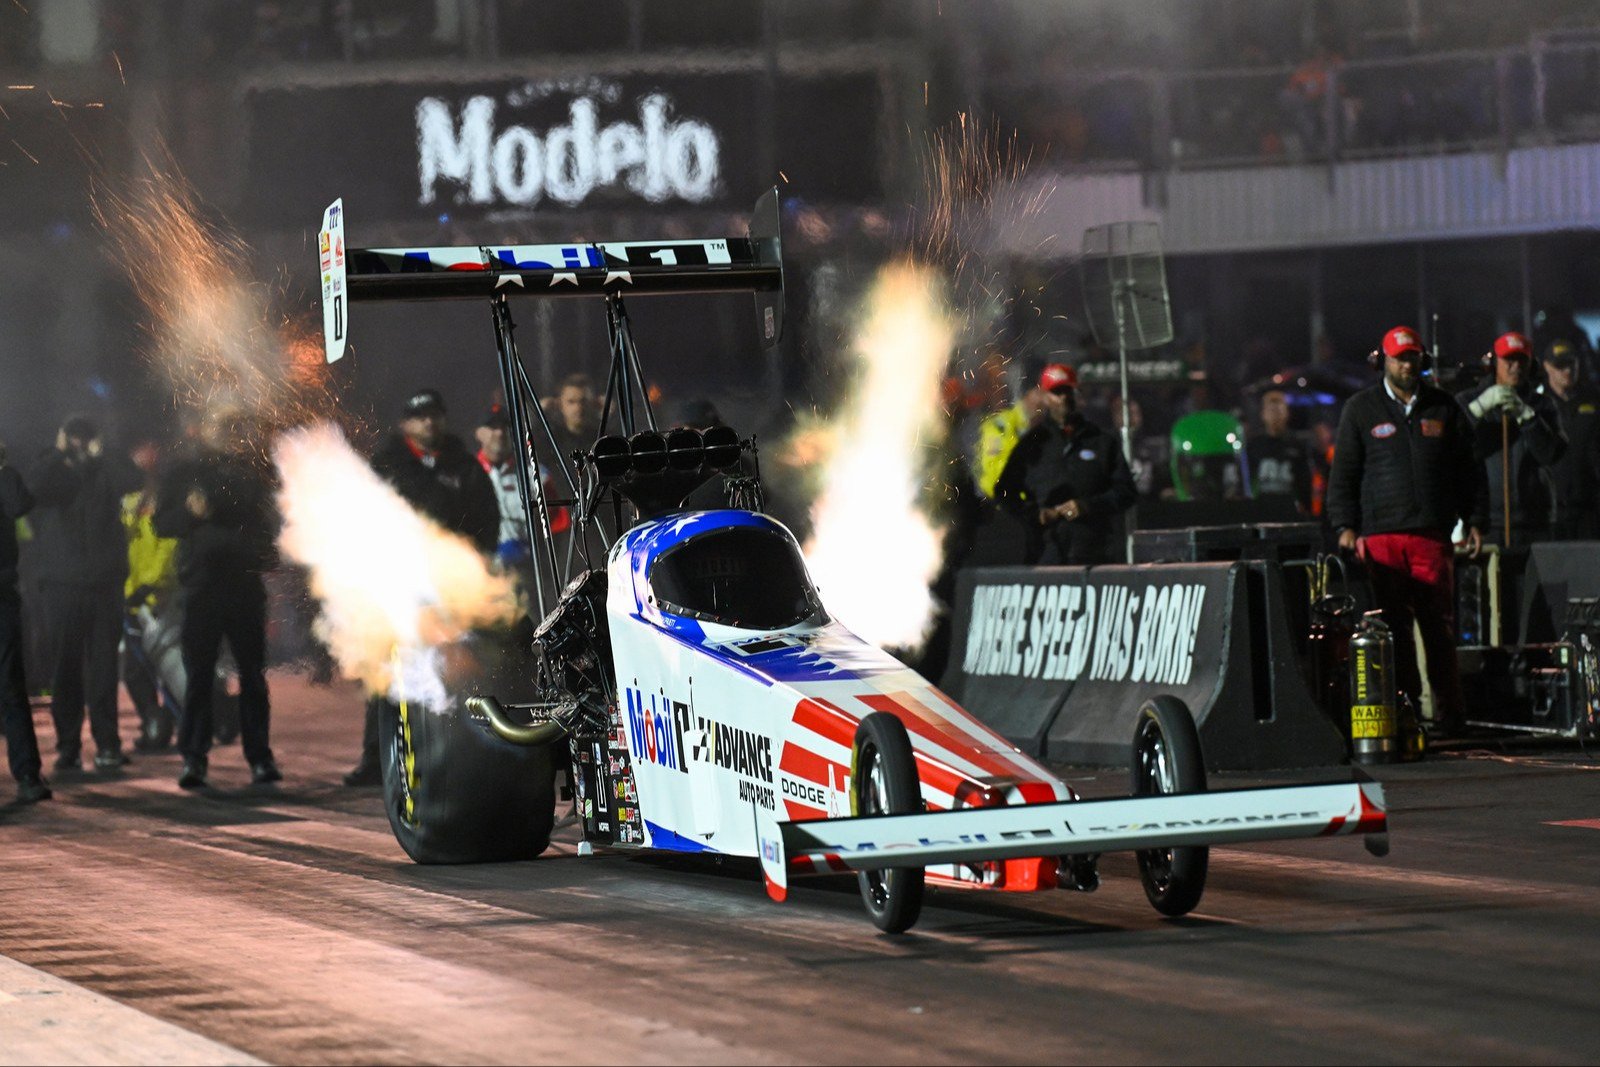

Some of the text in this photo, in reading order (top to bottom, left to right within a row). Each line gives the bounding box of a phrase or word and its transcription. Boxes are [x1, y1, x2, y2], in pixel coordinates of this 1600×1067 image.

[415, 94, 720, 204] Modelo
[710, 242, 726, 251] TM
[962, 583, 1207, 685] WHERE SPEED WAS BORN!
[626, 687, 677, 770] Mobil
[714, 721, 775, 784] ADVANCE
[738, 779, 776, 813] AUTO PARTS
[781, 777, 826, 805] DODGE
